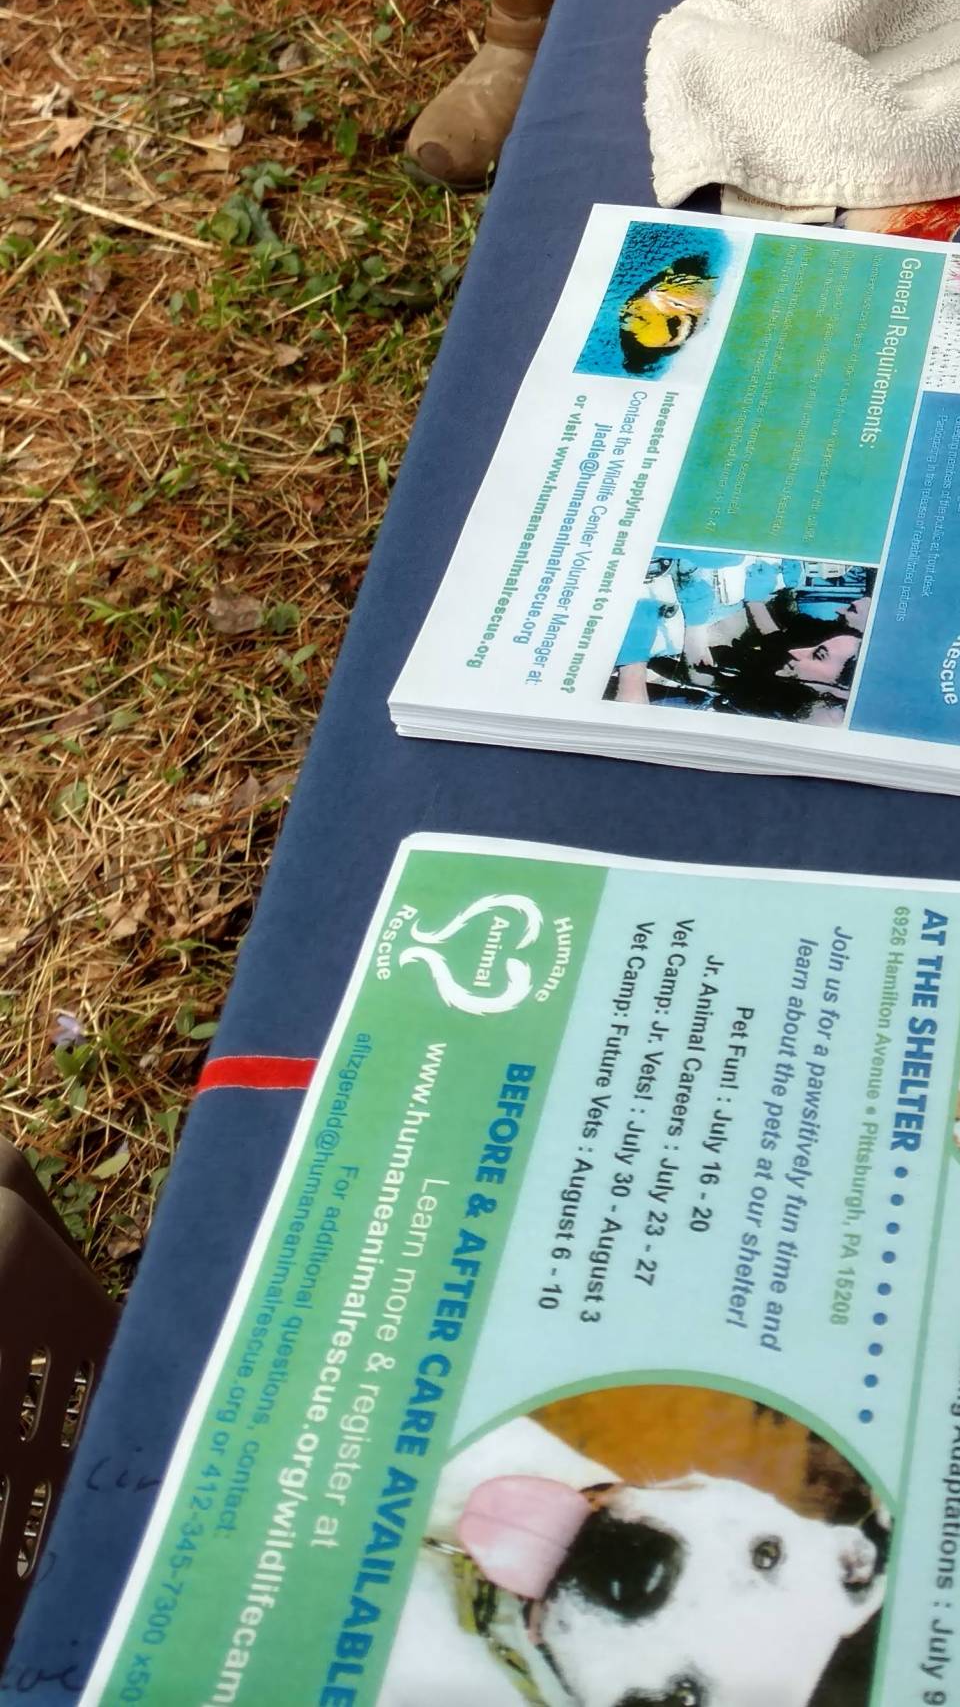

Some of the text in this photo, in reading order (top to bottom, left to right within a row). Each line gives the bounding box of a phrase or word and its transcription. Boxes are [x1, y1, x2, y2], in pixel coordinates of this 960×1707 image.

[593, 458, 622, 502] Wildlife
[610, 436, 631, 455] the
[618, 390, 647, 434] Contact
[853, 257, 922, 449] General Requirements:
[466, 395, 587, 669] or visit www.humaneanimalrescue.org
[528, 613, 566, 667] Manager
[552, 549, 589, 610] Volunteer
[560, 391, 678, 694] Interested in applying and want to learn more?
[576, 505, 606, 546] Center
[376, 904, 418, 980] Rescue
[473, 917, 511, 987] Animal
[535, 916, 574, 1003] Humane
[889, 908, 950, 1151] AT THE SHELTER
[535, 921, 655, 1310] Vet Camp: Future Vets August 6 10
[578, 918, 695, 1324] Vet Camp: Jr. Vets! July 30 August 3
[631, 954, 725, 1286] Jr. Animal Careers July 23 27
[687, 1006, 754, 1232] Pet Fun! July 16 20
[723, 938, 819, 1328] learn about the pets at our shelter!
[757, 926, 854, 1351] Join us for a pawsitively fun time and
[827, 906, 911, 1325] 6926 Hamilton Avenue Pittsburgh, PA 15208
[114, 1033, 377, 1707] afitzgerald@humaneanimalrescue.org or 412-345-7300 x50
[200, 1042, 454, 1707] www.humaneanimalrescue.org/wildlifecam
[212, 1166, 360, 1539] For additional questions, contact:
[307, 1178, 449, 1548] Learn more & register at
[316, 1062, 537, 1707] BEFORE & AFTER CARE AVAILABLE
